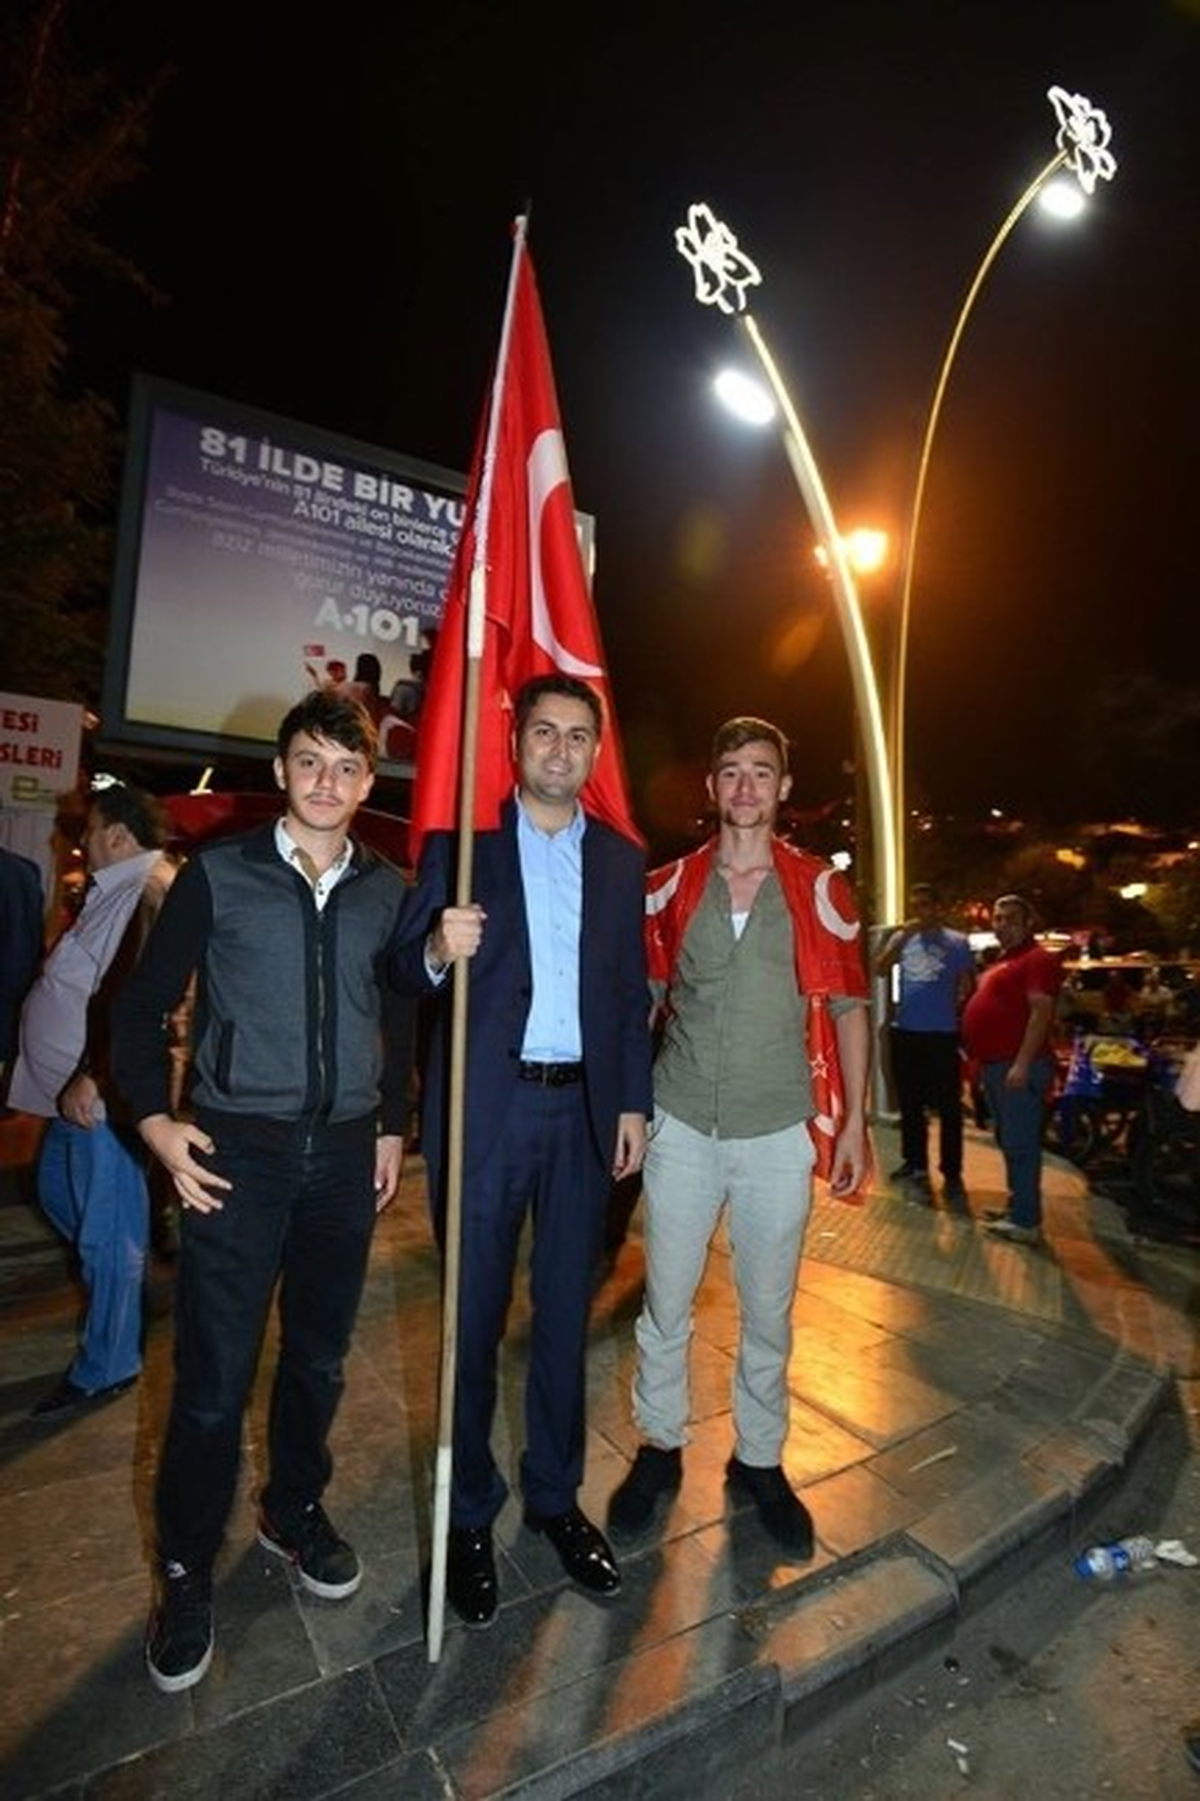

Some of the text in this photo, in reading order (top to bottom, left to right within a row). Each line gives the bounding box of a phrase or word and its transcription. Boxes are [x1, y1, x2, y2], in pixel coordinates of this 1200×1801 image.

[200, 427, 247, 464] 81
[259, 436, 344, 492] İLDE
[354, 472, 415, 513] BİR
[293, 500, 340, 526] A101
